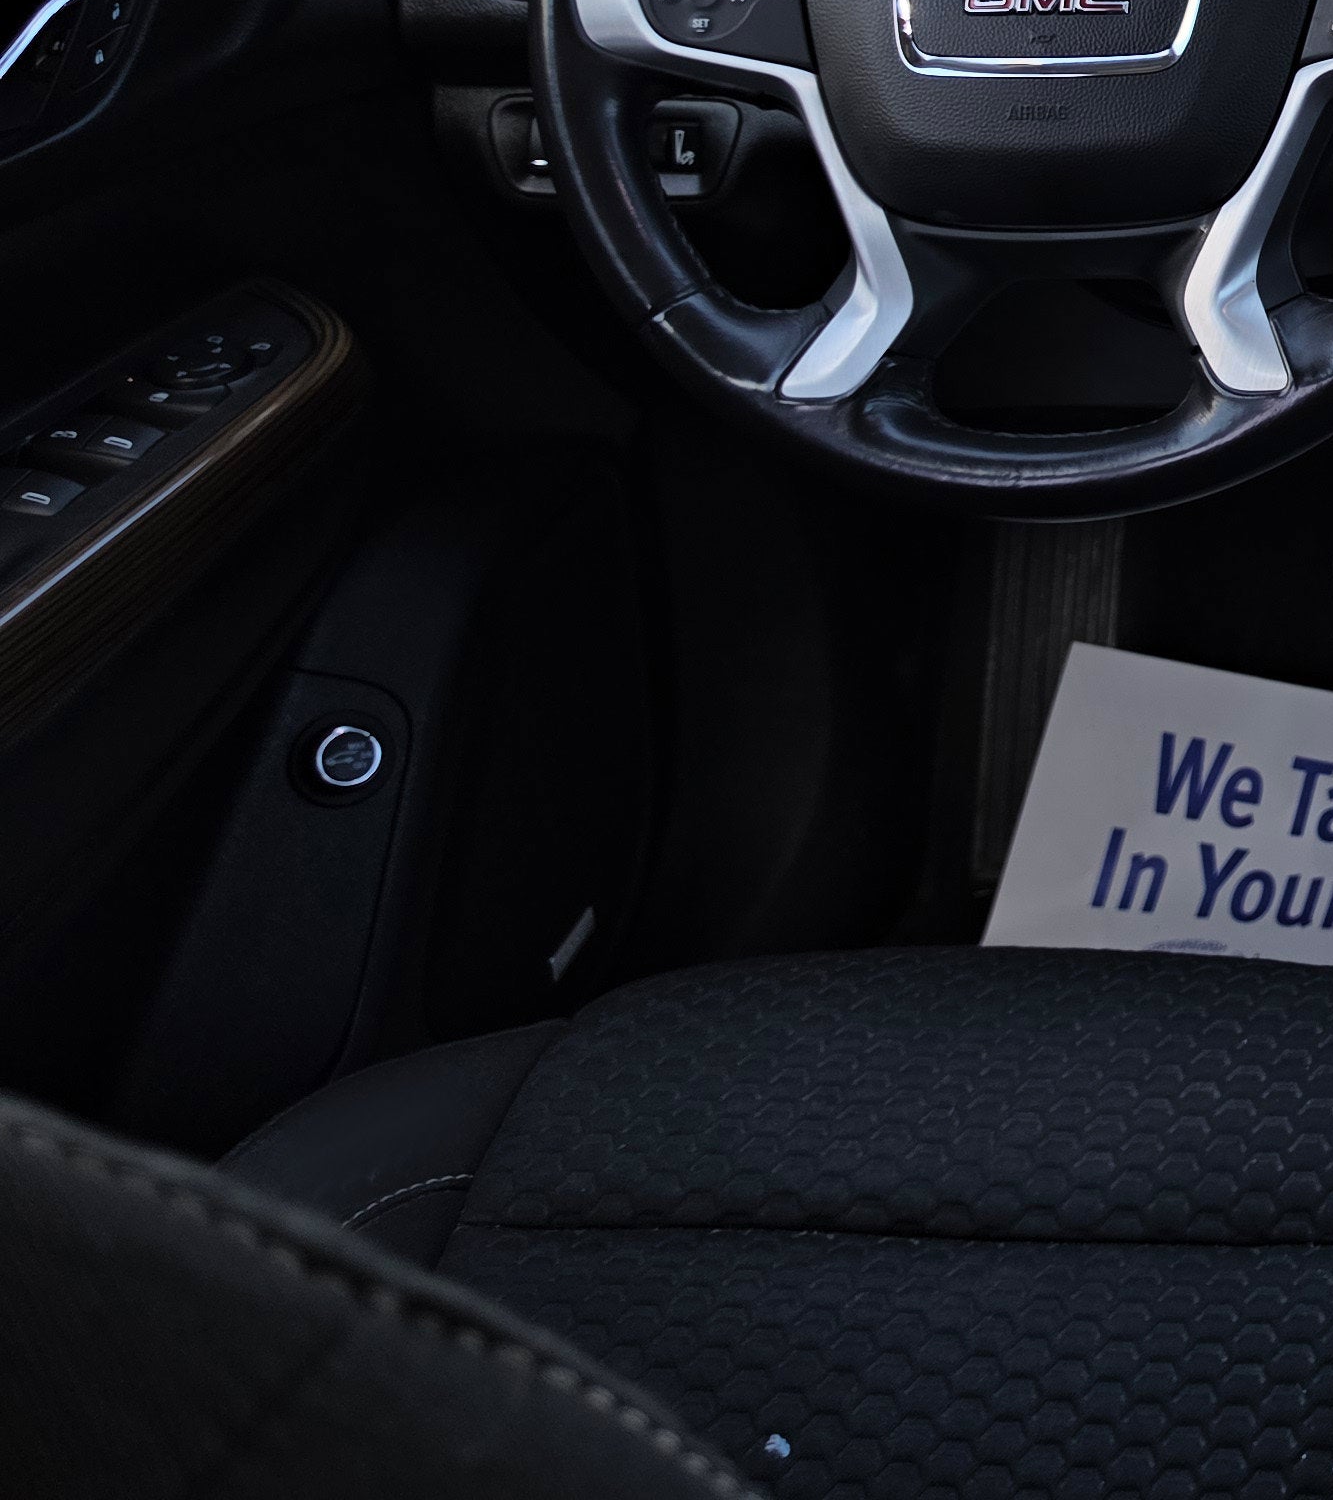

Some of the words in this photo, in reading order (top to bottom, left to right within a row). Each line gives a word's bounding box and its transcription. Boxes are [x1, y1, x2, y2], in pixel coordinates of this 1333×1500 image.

[691, 18, 710, 28] SET
[1153, 731, 1263, 829] We
[1090, 827, 1168, 913] In
